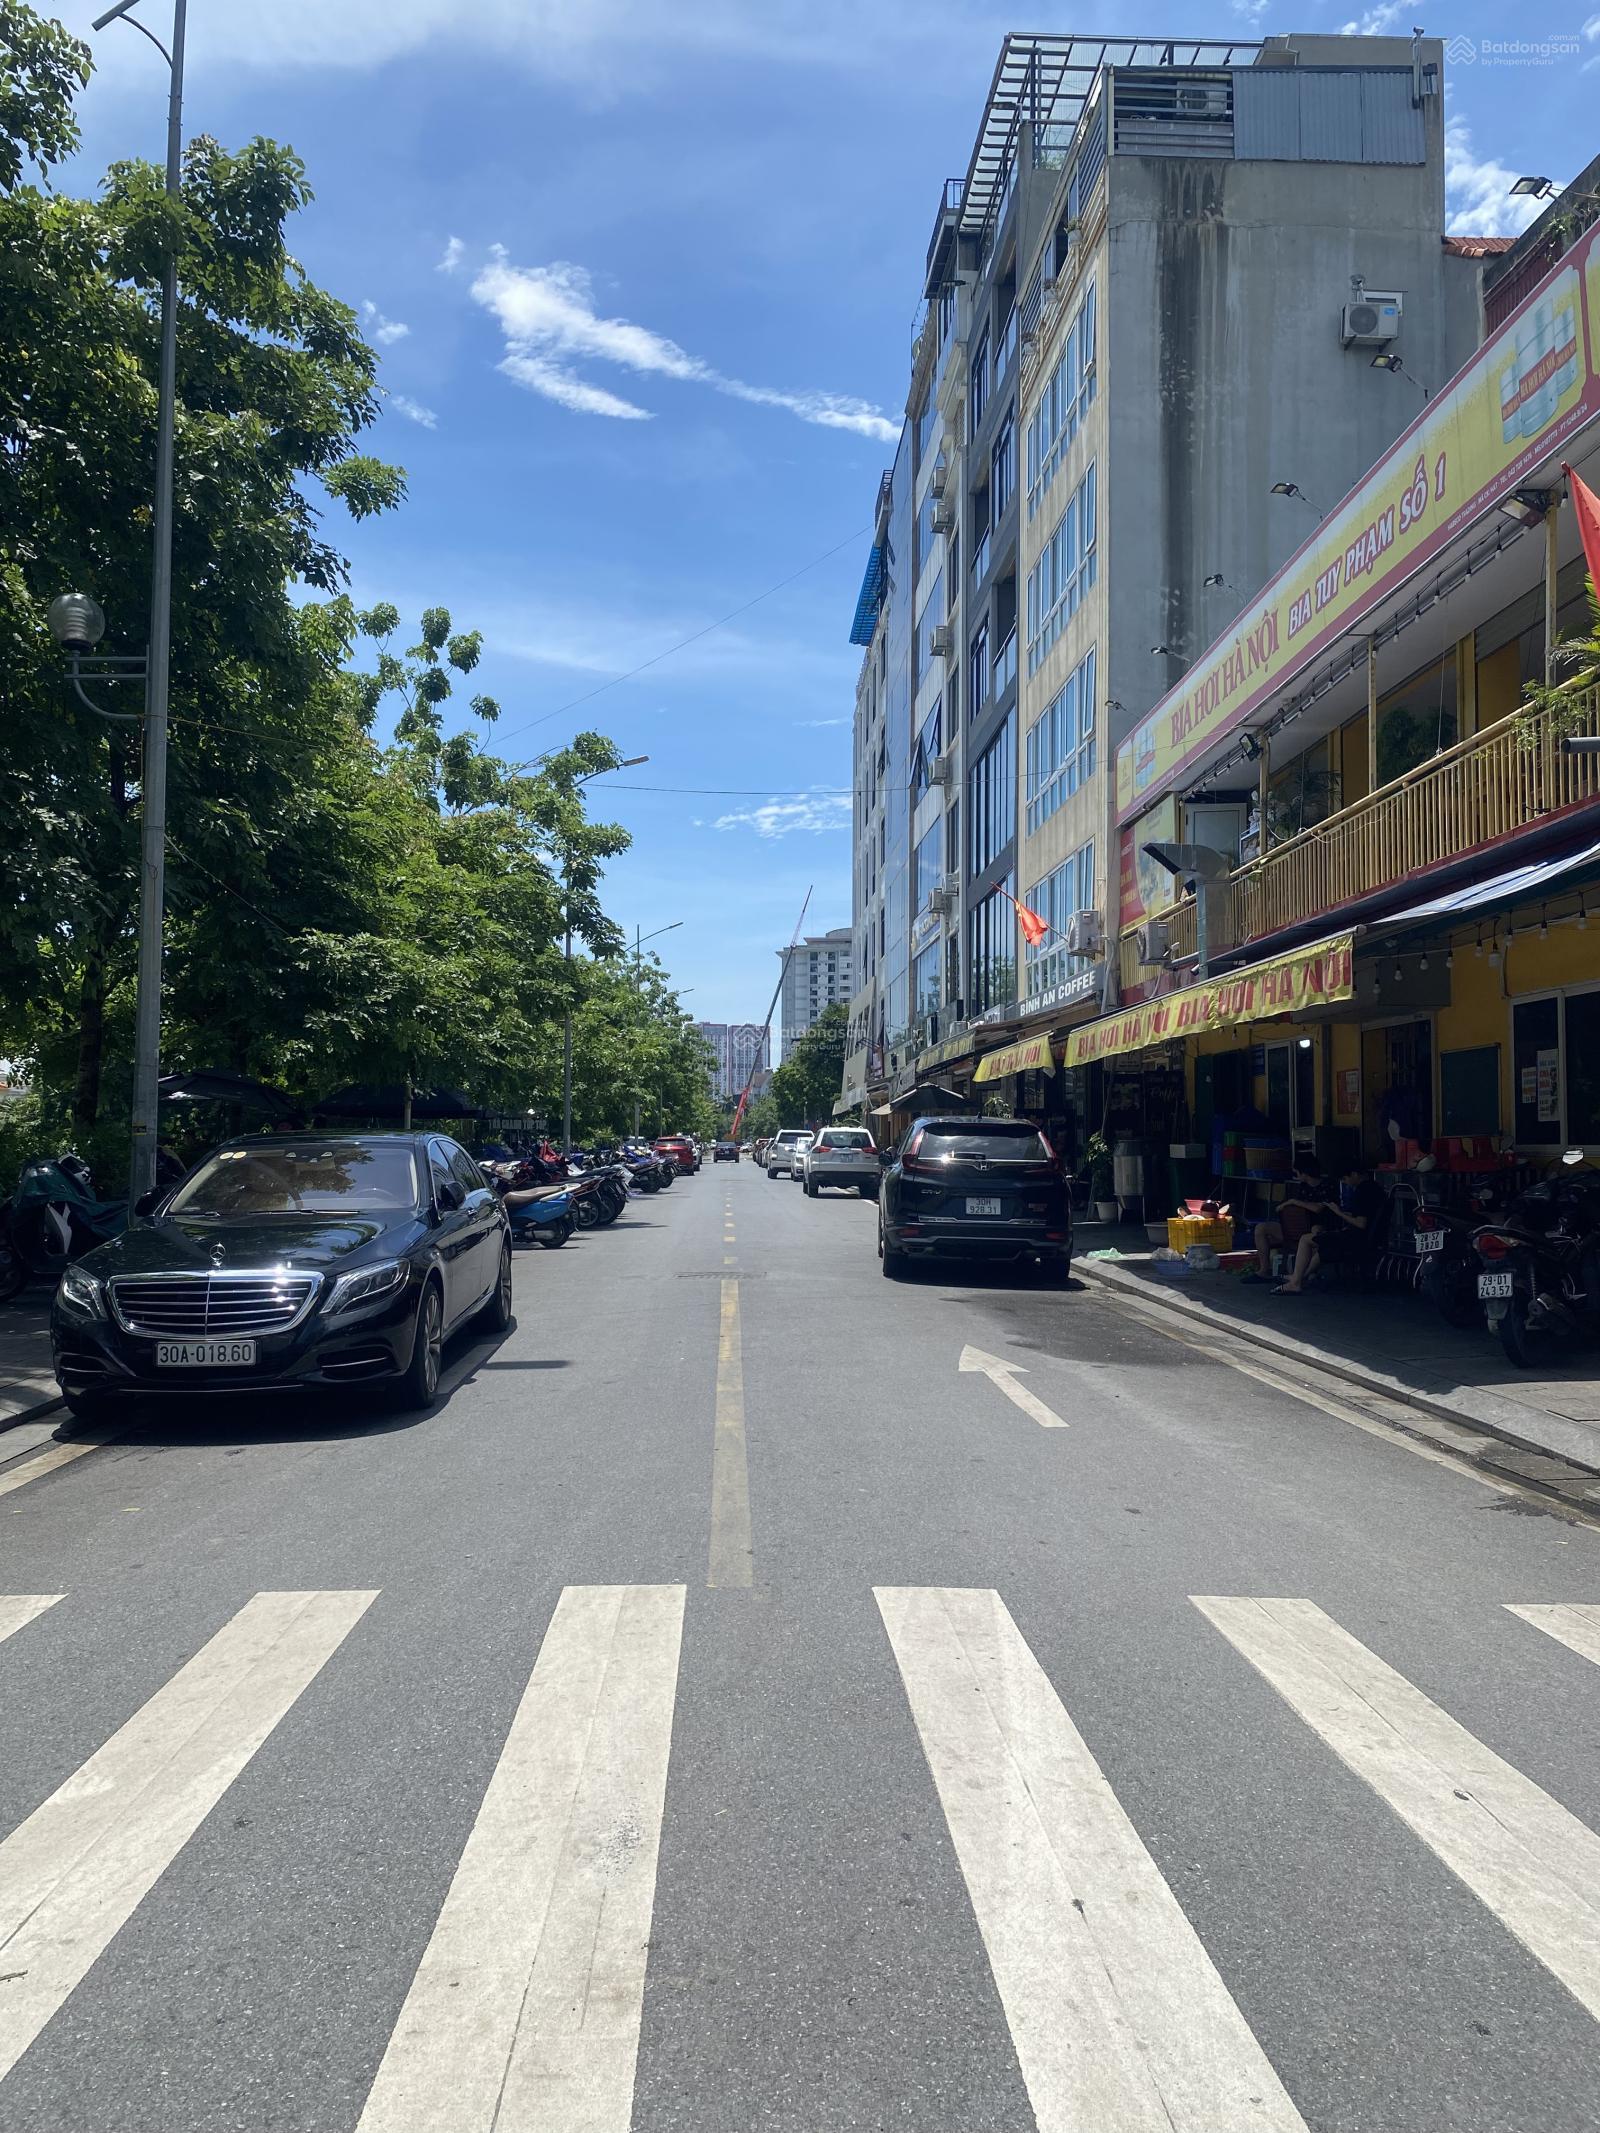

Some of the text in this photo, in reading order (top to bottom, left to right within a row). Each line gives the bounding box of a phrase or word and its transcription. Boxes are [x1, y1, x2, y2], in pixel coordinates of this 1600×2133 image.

[1171, 702, 1193, 749] BIA
[1222, 638, 1247, 702] HÀ
[1247, 608, 1280, 678] NỘI
[1288, 588, 1312, 640] BIA
[1315, 555, 1342, 614] TUY
[1344, 503, 1395, 588] PHẠM
[1400, 454, 1428, 535] SỐ
[1435, 451, 1447, 501] 1
[1042, 989, 1056, 1008] AN
[1057, 970, 1097, 1000] COFFEE
[1077, 1033, 1096, 1058] BIA
[1176, 994, 1211, 1028] BIA
[160, 1344, 252, 1363] 30A-018.60
